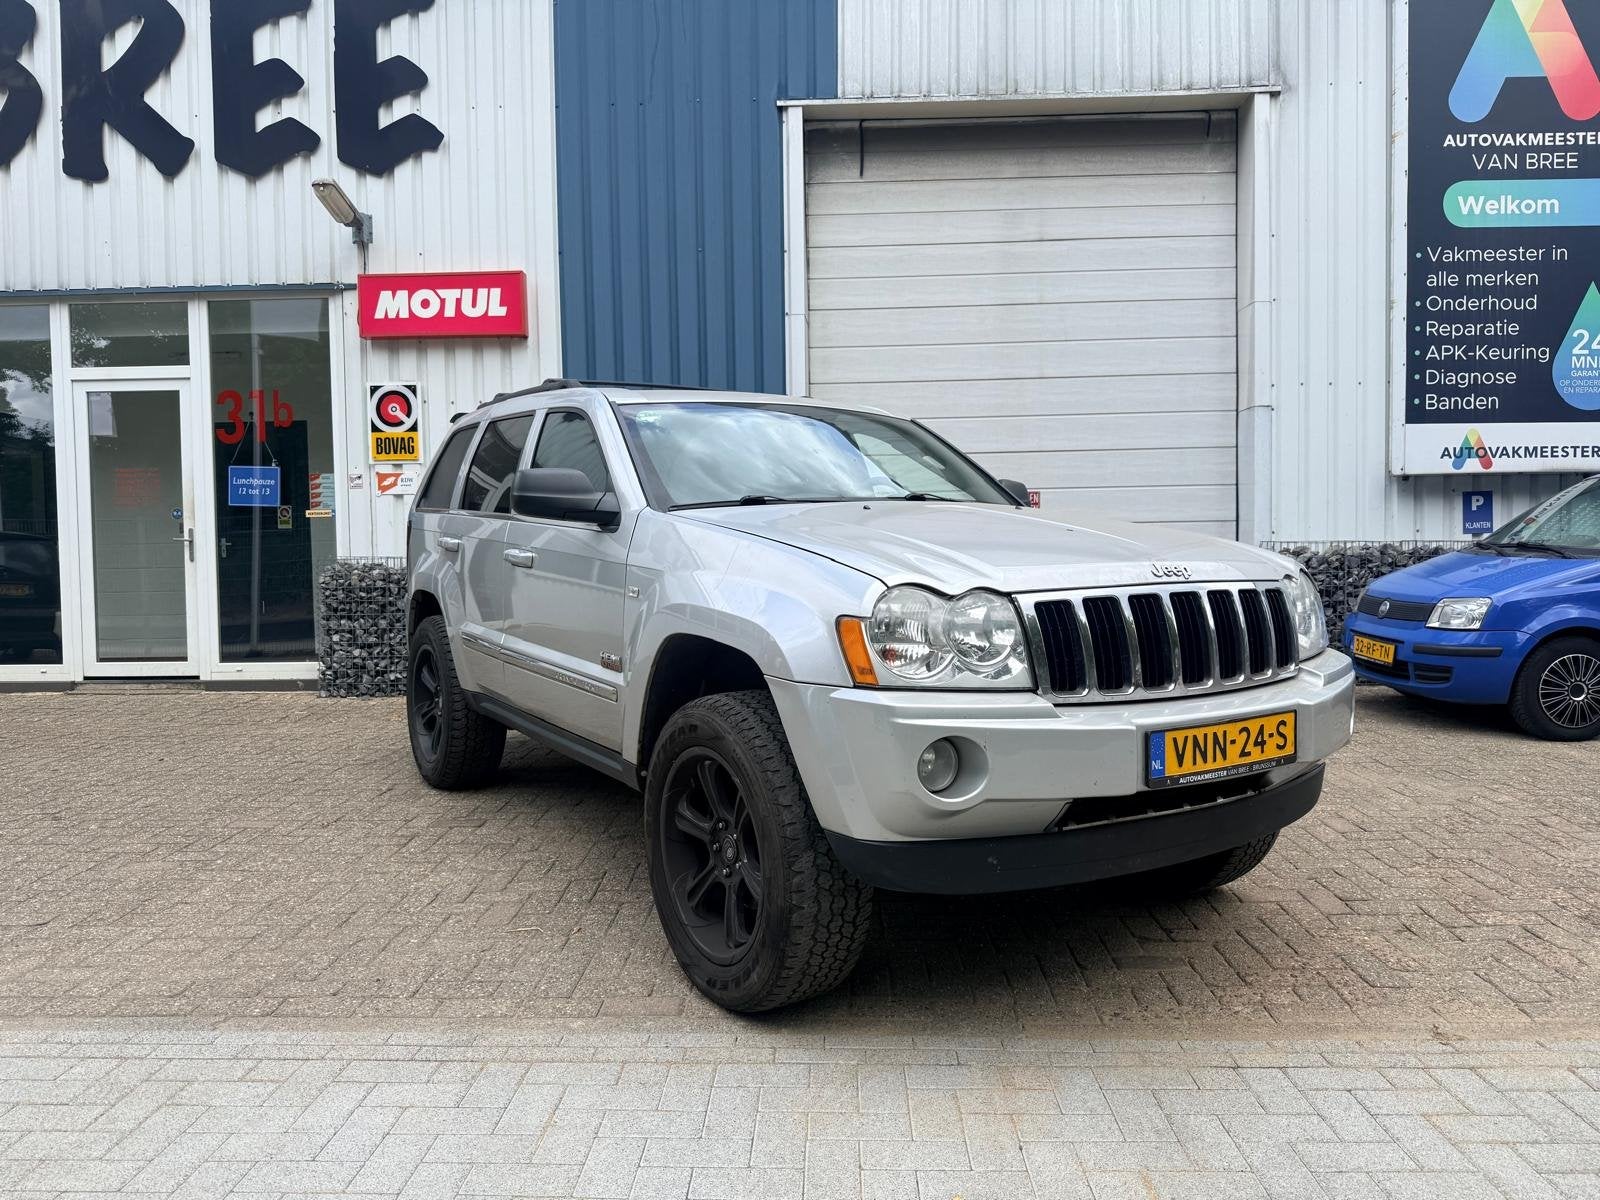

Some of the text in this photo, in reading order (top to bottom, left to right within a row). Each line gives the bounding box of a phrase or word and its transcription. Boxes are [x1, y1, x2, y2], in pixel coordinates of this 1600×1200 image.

[1443, 131, 1600, 147] AUTOVAKMEESTE
[1472, 152, 1579, 170] VAN BREE
[1457, 195, 1560, 215] Welkom
[1426, 245, 1568, 262] Vakmeester in
[1426, 270, 1539, 287] alle merken
[374, 287, 508, 320] MOTUL
[1426, 294, 1538, 311] Onderhoud
[1426, 319, 1520, 339] Reparatie
[1425, 344, 1550, 363] APK-Keuring
[1425, 369, 1517, 388] Diagnose
[1560, 379, 1571, 387] OP
[1563, 386, 1574, 394] EN
[1425, 393, 1499, 410] Banden
[375, 436, 415, 456] BOVAG
[1440, 445, 1600, 459] AUTOVAKMEESTER
[232, 476, 276, 487] Lunchpauze
[238, 487, 247, 495] 12
[261, 487, 271, 495] 13
[1471, 495, 1484, 511] P
[1465, 521, 1491, 529] KLANTEN
[1150, 561, 1192, 579] Jeep
[1355, 638, 1391, 660] 32-RF-TN
[1172, 719, 1289, 768] VNN-24-S
[1151, 760, 1164, 771] NL
[1178, 770, 1227, 784] AUTOVAKMEESTER
[1238, 766, 1250, 774] BREE
